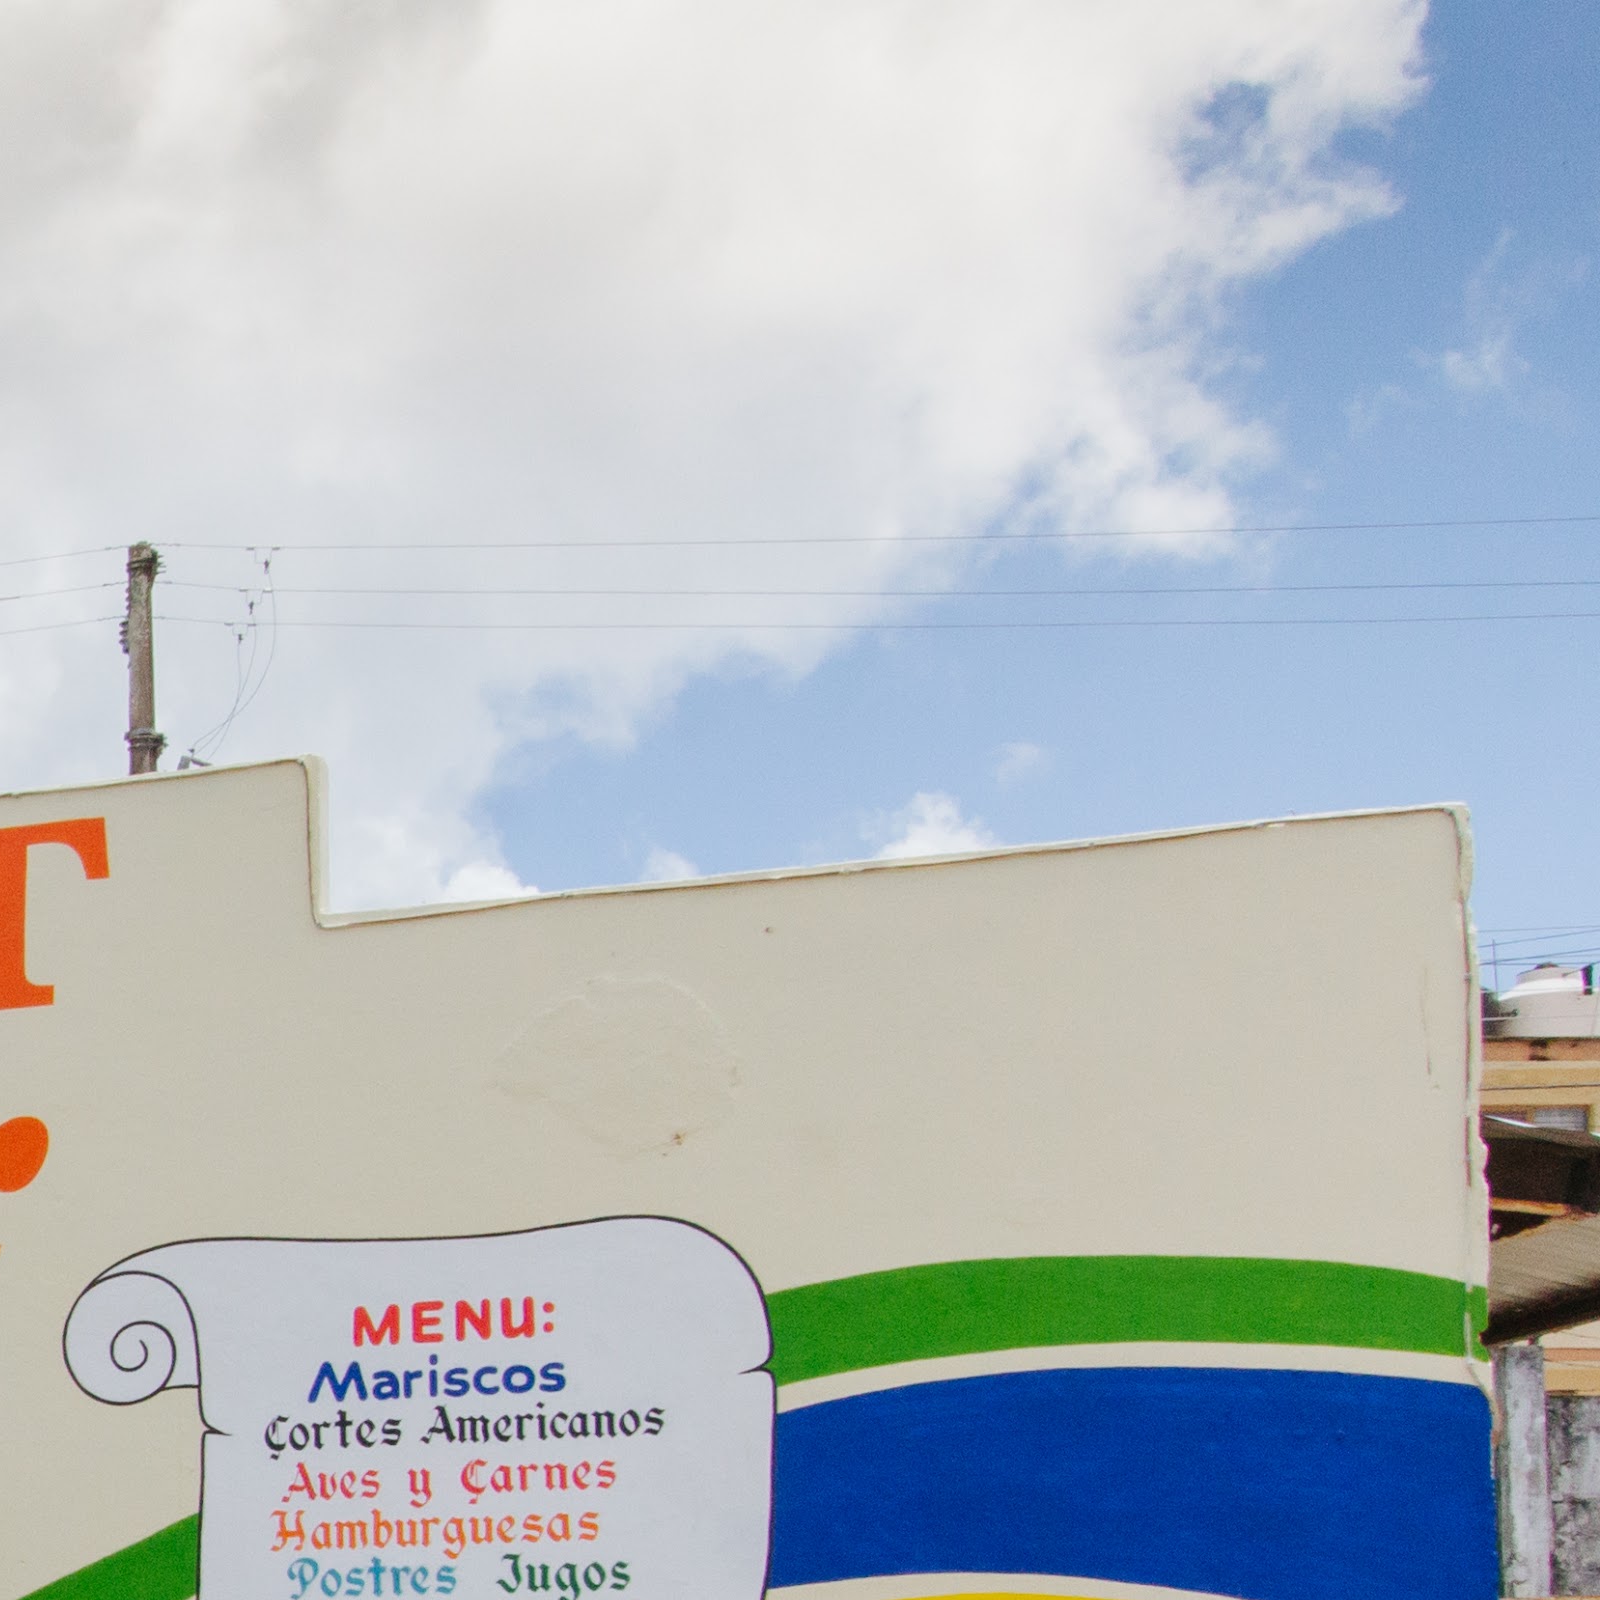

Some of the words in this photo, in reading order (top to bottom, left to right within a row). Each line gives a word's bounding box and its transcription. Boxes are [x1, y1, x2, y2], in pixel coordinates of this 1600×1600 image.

[352, 1296, 556, 1347] MENU:
[307, 1353, 567, 1404] Mariscos
[264, 1410, 402, 1461] Cortes
[420, 1402, 666, 1445] Americanos
[282, 1463, 381, 1502] Aves
[407, 1468, 433, 1509] y
[459, 1458, 617, 1502] Carnes
[271, 1509, 600, 1561] Hamburguesas
[287, 1556, 457, 1600] Postres
